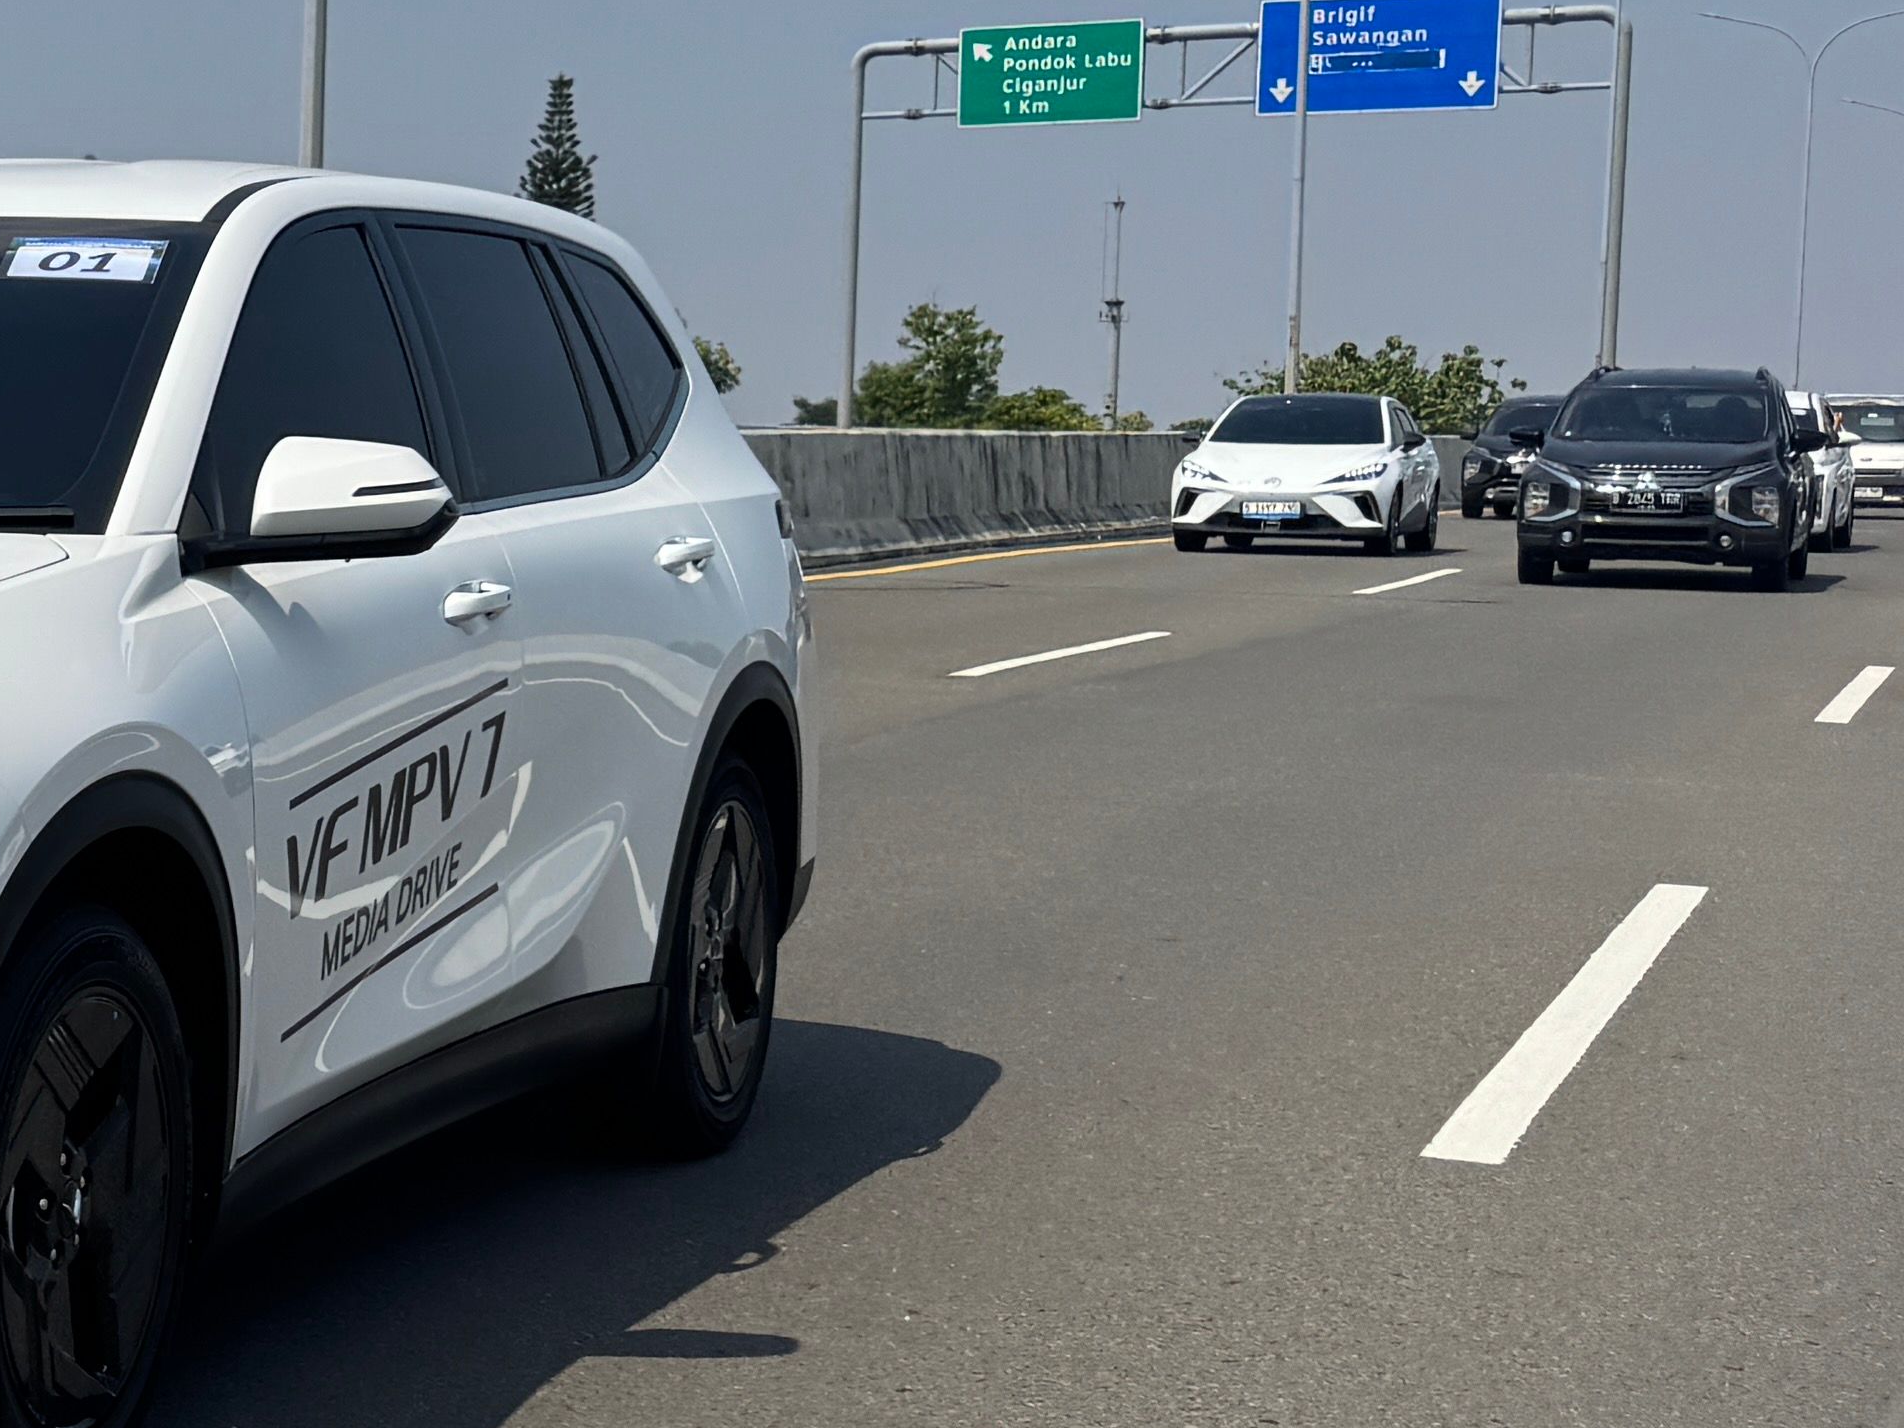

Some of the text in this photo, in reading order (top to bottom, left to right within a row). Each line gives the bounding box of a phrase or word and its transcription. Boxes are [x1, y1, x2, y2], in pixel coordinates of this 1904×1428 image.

[1312, 5, 1376, 27] Brigif
[1004, 34, 1077, 52] Andara
[1312, 29, 1428, 47] Sawangan
[1003, 52, 1132, 72] Pondok Labu
[1002, 75, 1087, 97] Ciganjur
[1003, 100, 1050, 115] 1 Km
[38, 251, 118, 273] 01
[286, 710, 507, 920] VF MPV 7
[320, 841, 463, 981] MEDIA DRIVE
